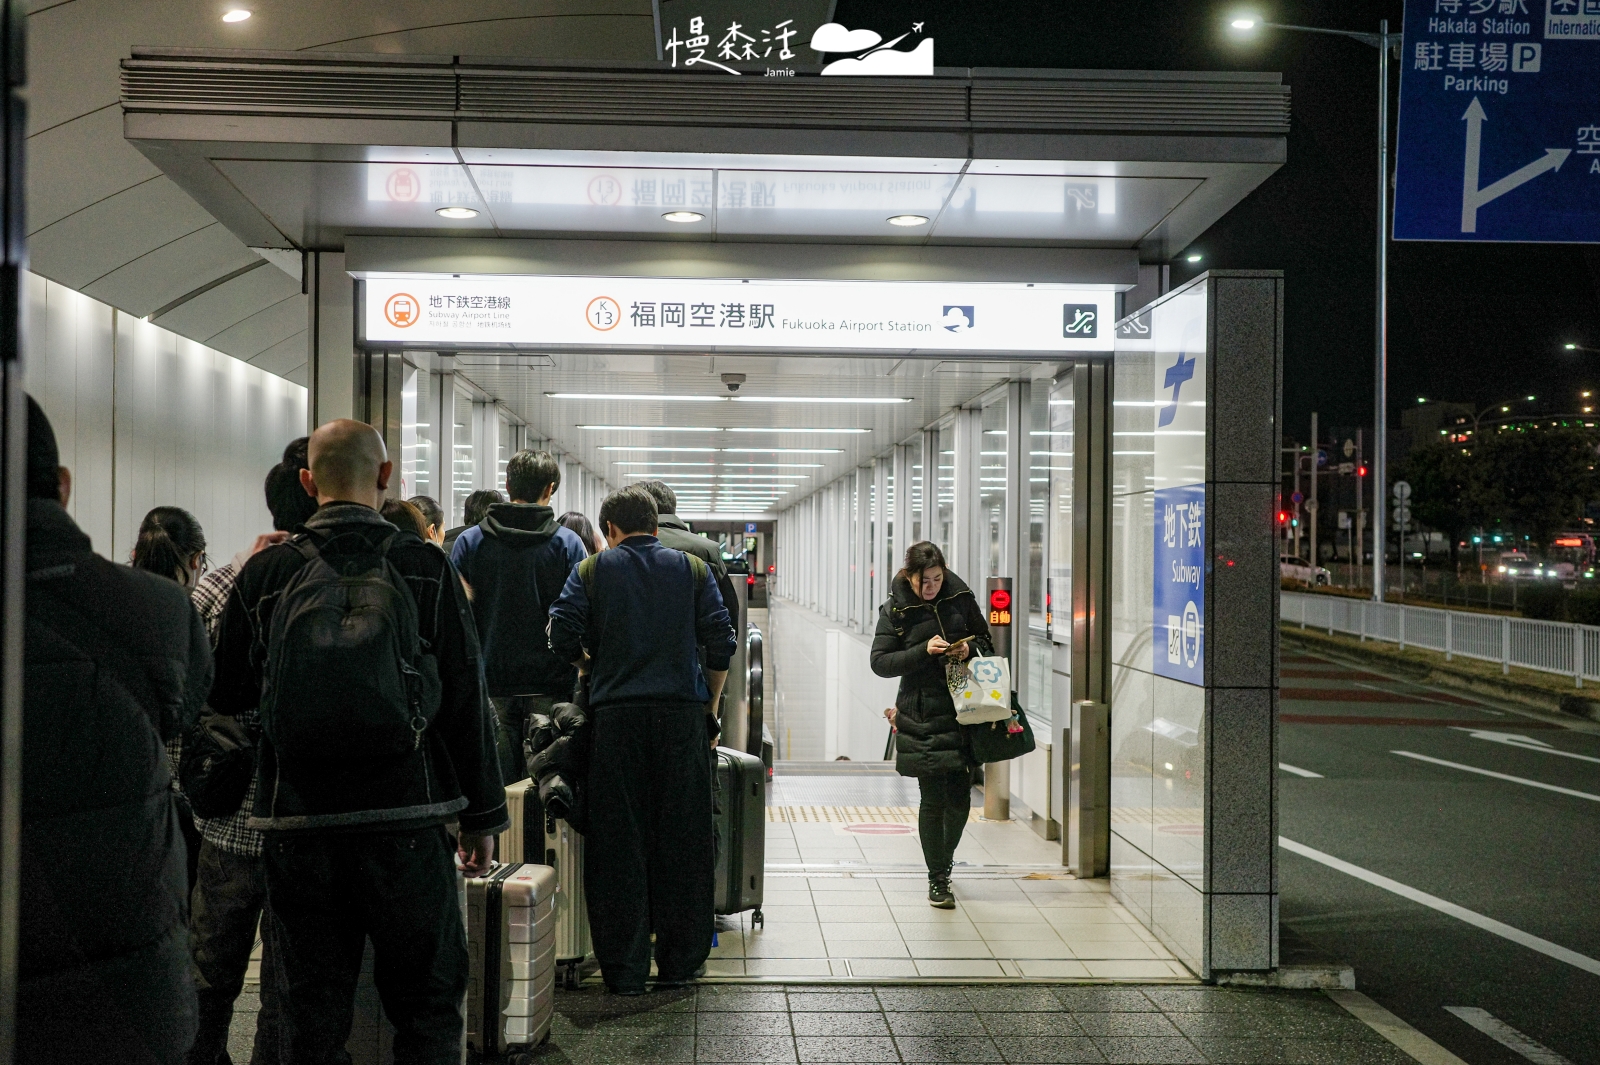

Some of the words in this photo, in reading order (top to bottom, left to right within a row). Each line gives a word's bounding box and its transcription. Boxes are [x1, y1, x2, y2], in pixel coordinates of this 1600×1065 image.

[1429, 17, 1476, 34] Hakata
[1482, 18, 1530, 35] Station
[1414, 42, 1508, 72] 駐車場
[1519, 46, 1536, 70] P
[1444, 76, 1508, 94] Parking
[428, 295, 511, 309] 地下鉄空港線
[599, 301, 607, 310] K
[428, 311, 459, 319] Subway
[462, 311, 491, 320] Airport
[594, 311, 613, 325] 13
[630, 301, 775, 329] 福岡空港駅
[782, 319, 835, 330] Fukuoka
[839, 319, 884, 333] Airport
[888, 320, 932, 332] Station
[748, 523, 755, 532] P
[1164, 501, 1202, 548] 地下鉄
[1172, 559, 1201, 590] Subway
[990, 610, 1011, 624] 自動
